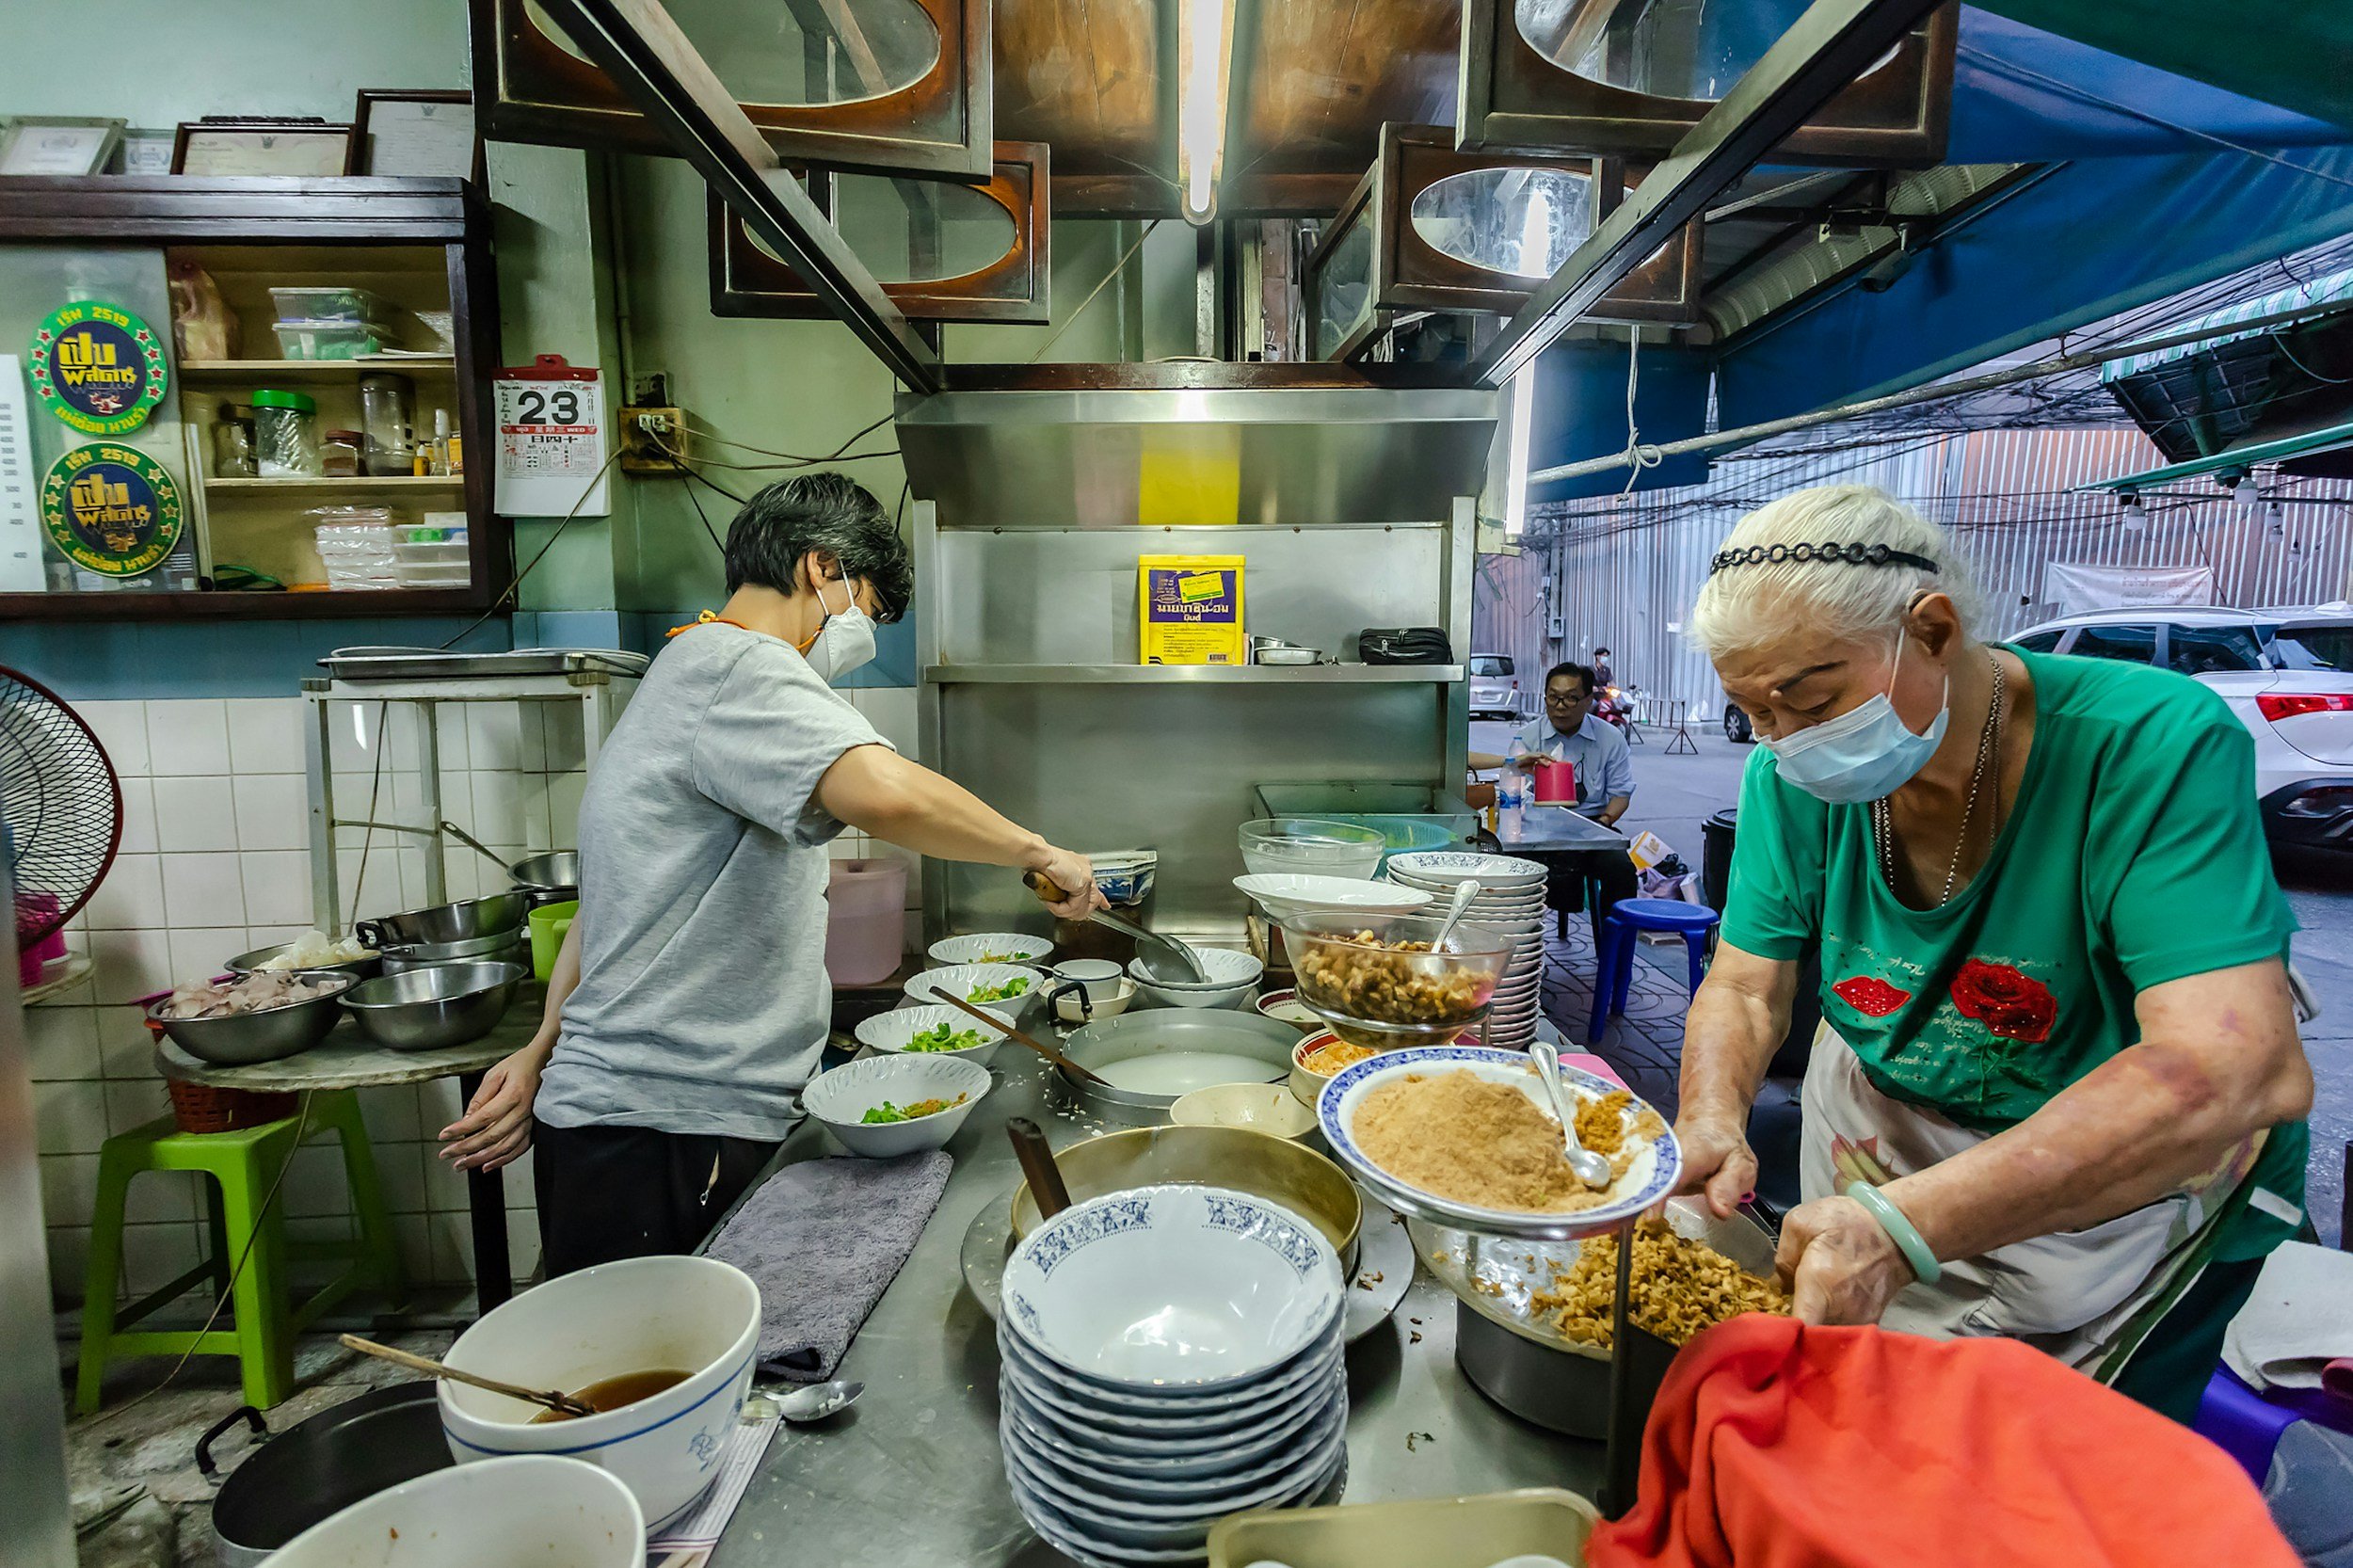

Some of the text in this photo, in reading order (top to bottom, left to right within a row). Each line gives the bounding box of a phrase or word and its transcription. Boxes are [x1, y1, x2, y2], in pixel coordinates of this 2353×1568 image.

[91, 306, 130, 328] 2519
[518, 391, 579, 424] 23
[100, 447, 141, 467] 2519
